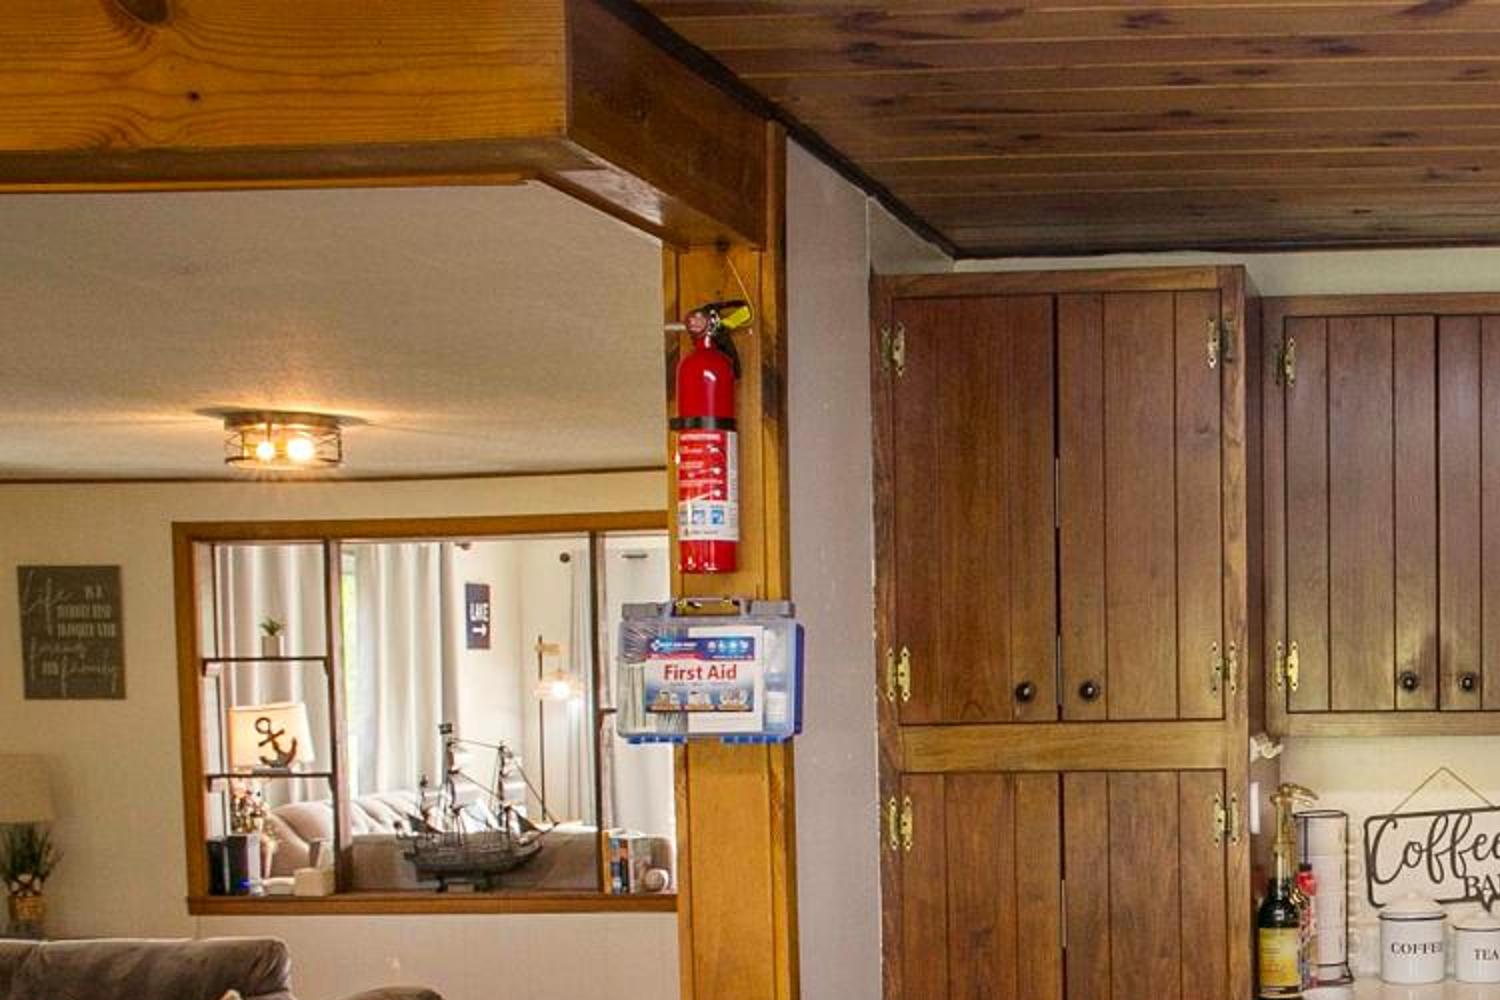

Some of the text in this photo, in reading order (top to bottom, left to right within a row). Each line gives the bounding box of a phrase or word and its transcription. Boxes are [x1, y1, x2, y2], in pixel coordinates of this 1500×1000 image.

[664, 663, 737, 680] First Aid
[1474, 948, 1500, 960] TEA
